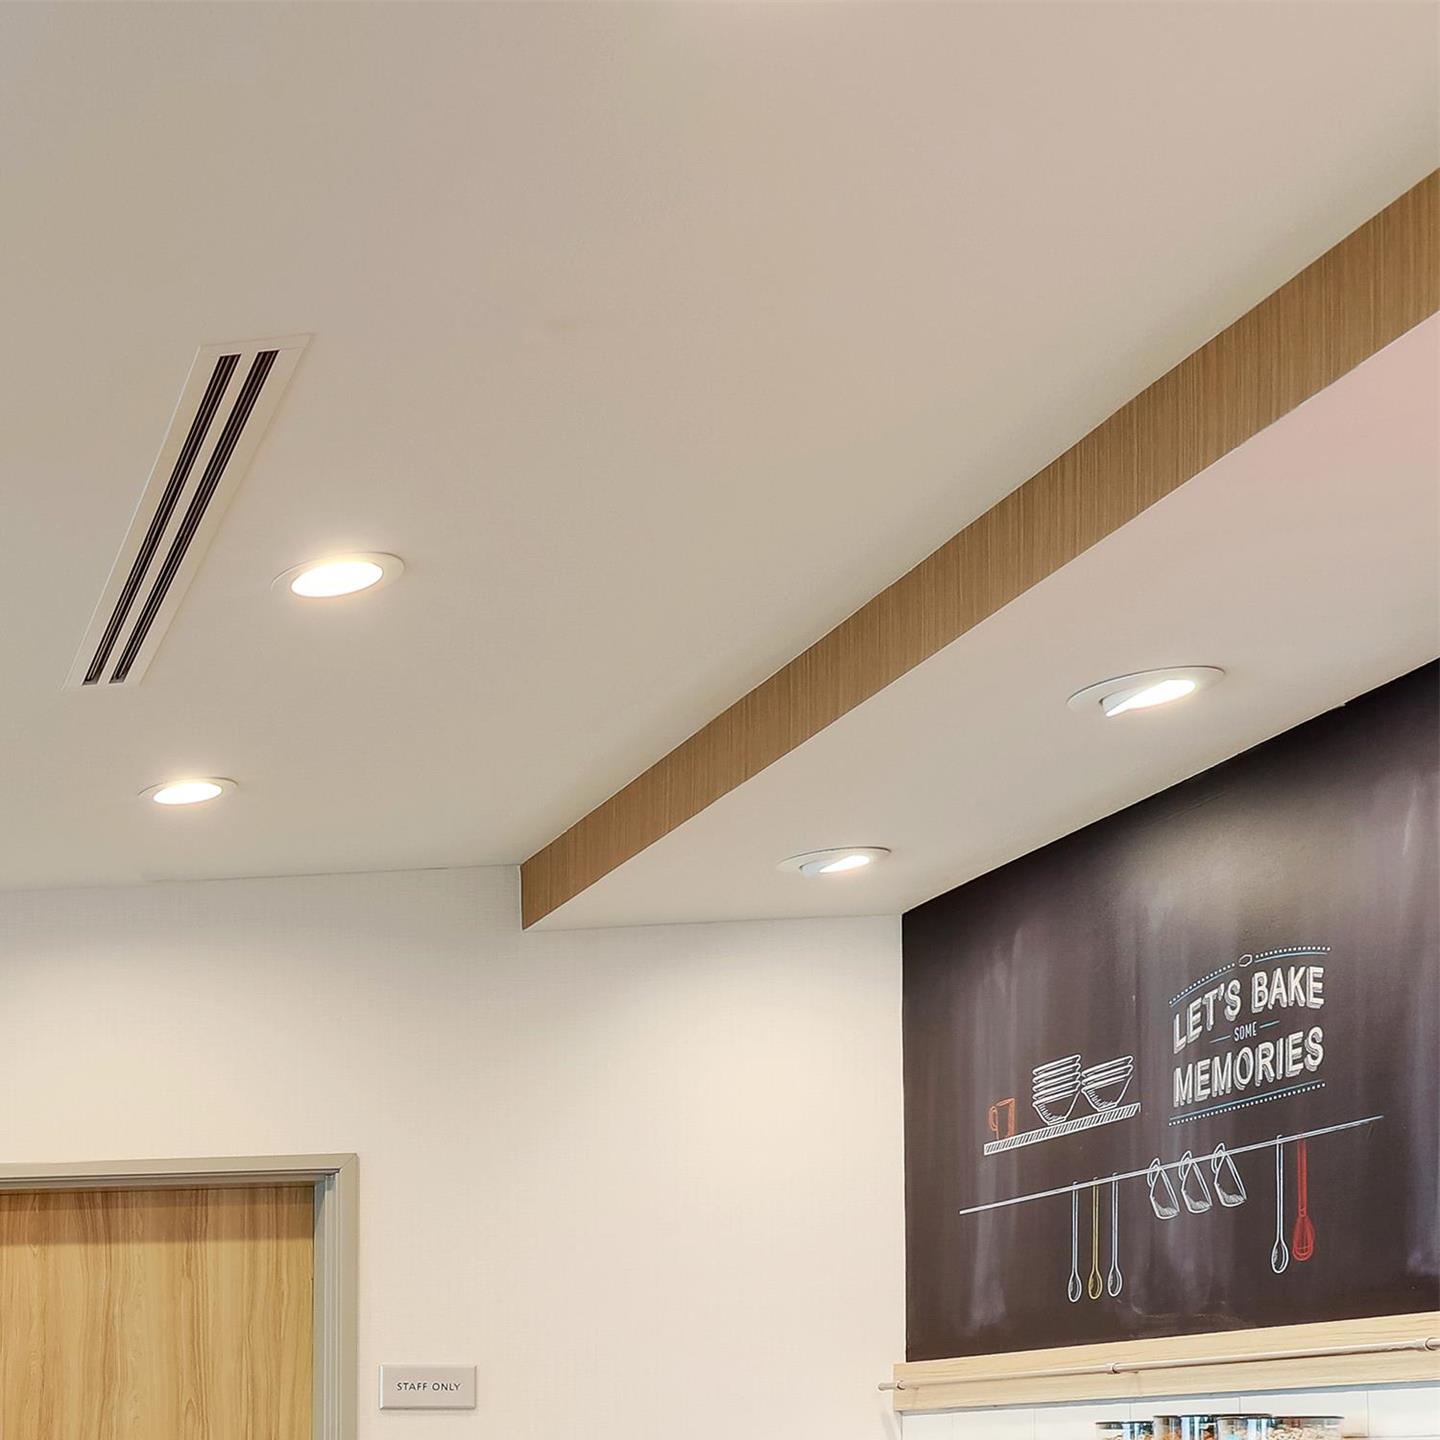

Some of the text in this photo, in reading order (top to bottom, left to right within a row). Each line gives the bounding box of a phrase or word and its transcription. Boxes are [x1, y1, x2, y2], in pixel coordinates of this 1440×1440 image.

[1173, 966, 1324, 1054] LET'S BAKE
[1234, 1021, 1257, 1041] SOME
[1173, 1026, 1324, 1107] MEMORIES
[396, 1382, 461, 1392] STAFF ONLY
